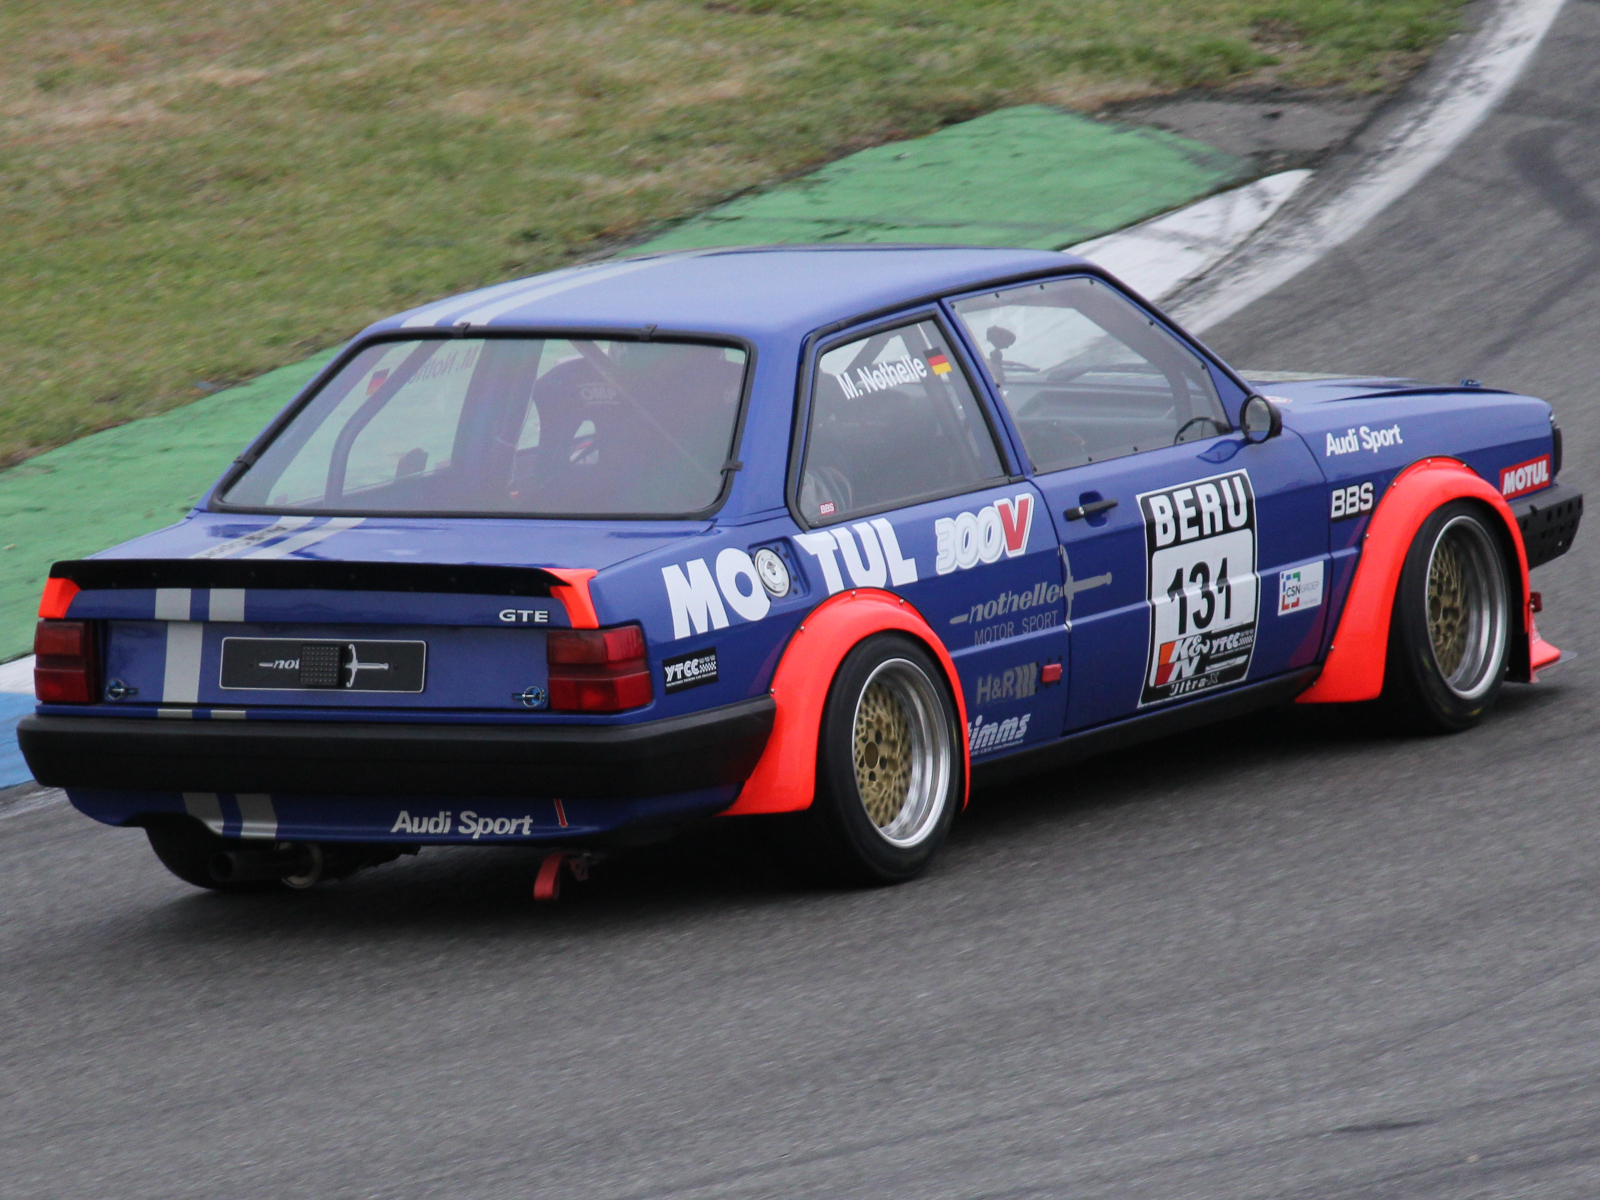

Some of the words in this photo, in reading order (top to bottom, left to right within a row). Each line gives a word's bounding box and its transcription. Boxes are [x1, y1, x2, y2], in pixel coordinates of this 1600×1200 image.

[836, 371, 863, 400] M.
[857, 354, 928, 393] Nothelle
[1326, 428, 1360, 457] Audi
[1359, 423, 1404, 454] Sport
[1502, 459, 1550, 496] MOTUL
[820, 502, 835, 514] BBS
[1149, 476, 1248, 548] BERU
[1331, 481, 1374, 518] BBS
[935, 493, 1034, 575] 300V
[1167, 556, 1231, 635] 131
[499, 608, 549, 623] GTE
[974, 621, 1015, 647] MOTOR
[1022, 609, 1059, 635] SPORT
[1210, 631, 1241, 655] YTCC
[664, 658, 700, 683] YTCC
[977, 670, 1015, 705] H&R
[390, 810, 452, 834] Audi
[458, 810, 533, 840] Sport
